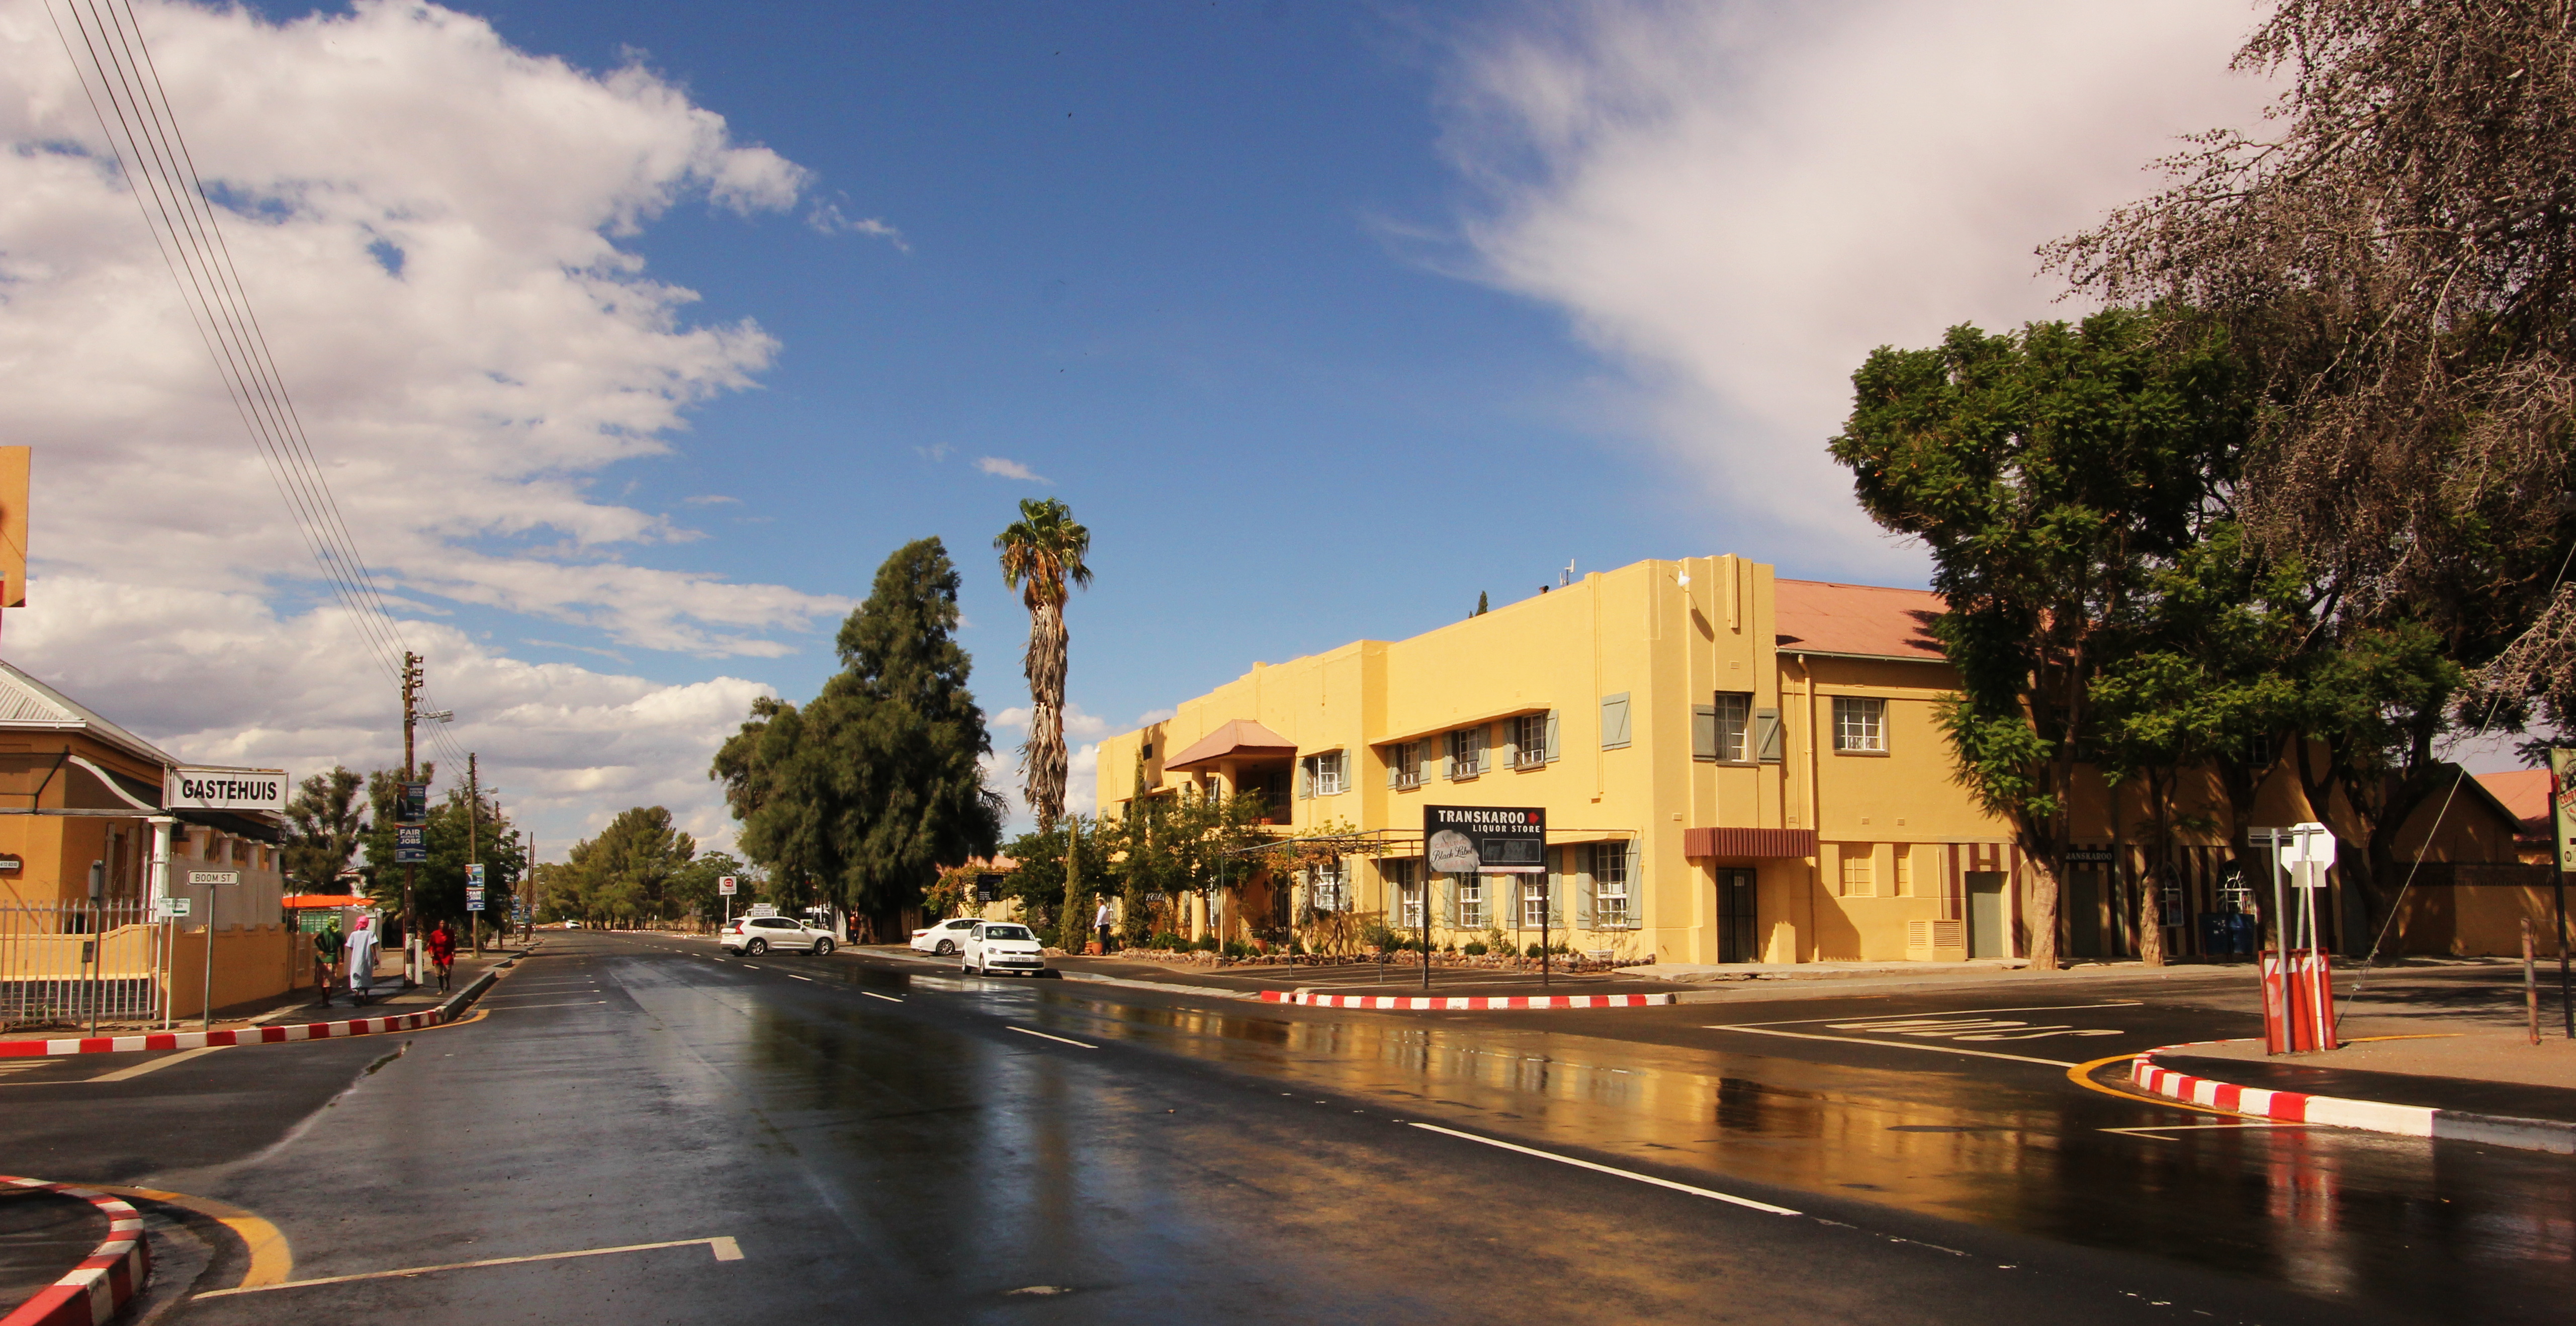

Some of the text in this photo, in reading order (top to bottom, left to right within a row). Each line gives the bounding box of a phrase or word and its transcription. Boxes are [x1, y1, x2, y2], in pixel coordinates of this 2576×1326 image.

[183, 779, 277, 801] GASTEHUIS
[1438, 810, 1526, 824] TRANSKAROO
[1472, 824, 1541, 834] LIQUOR STORE
[1431, 845, 1473, 862] Black Label
[195, 873, 231, 882] BOOM ST
